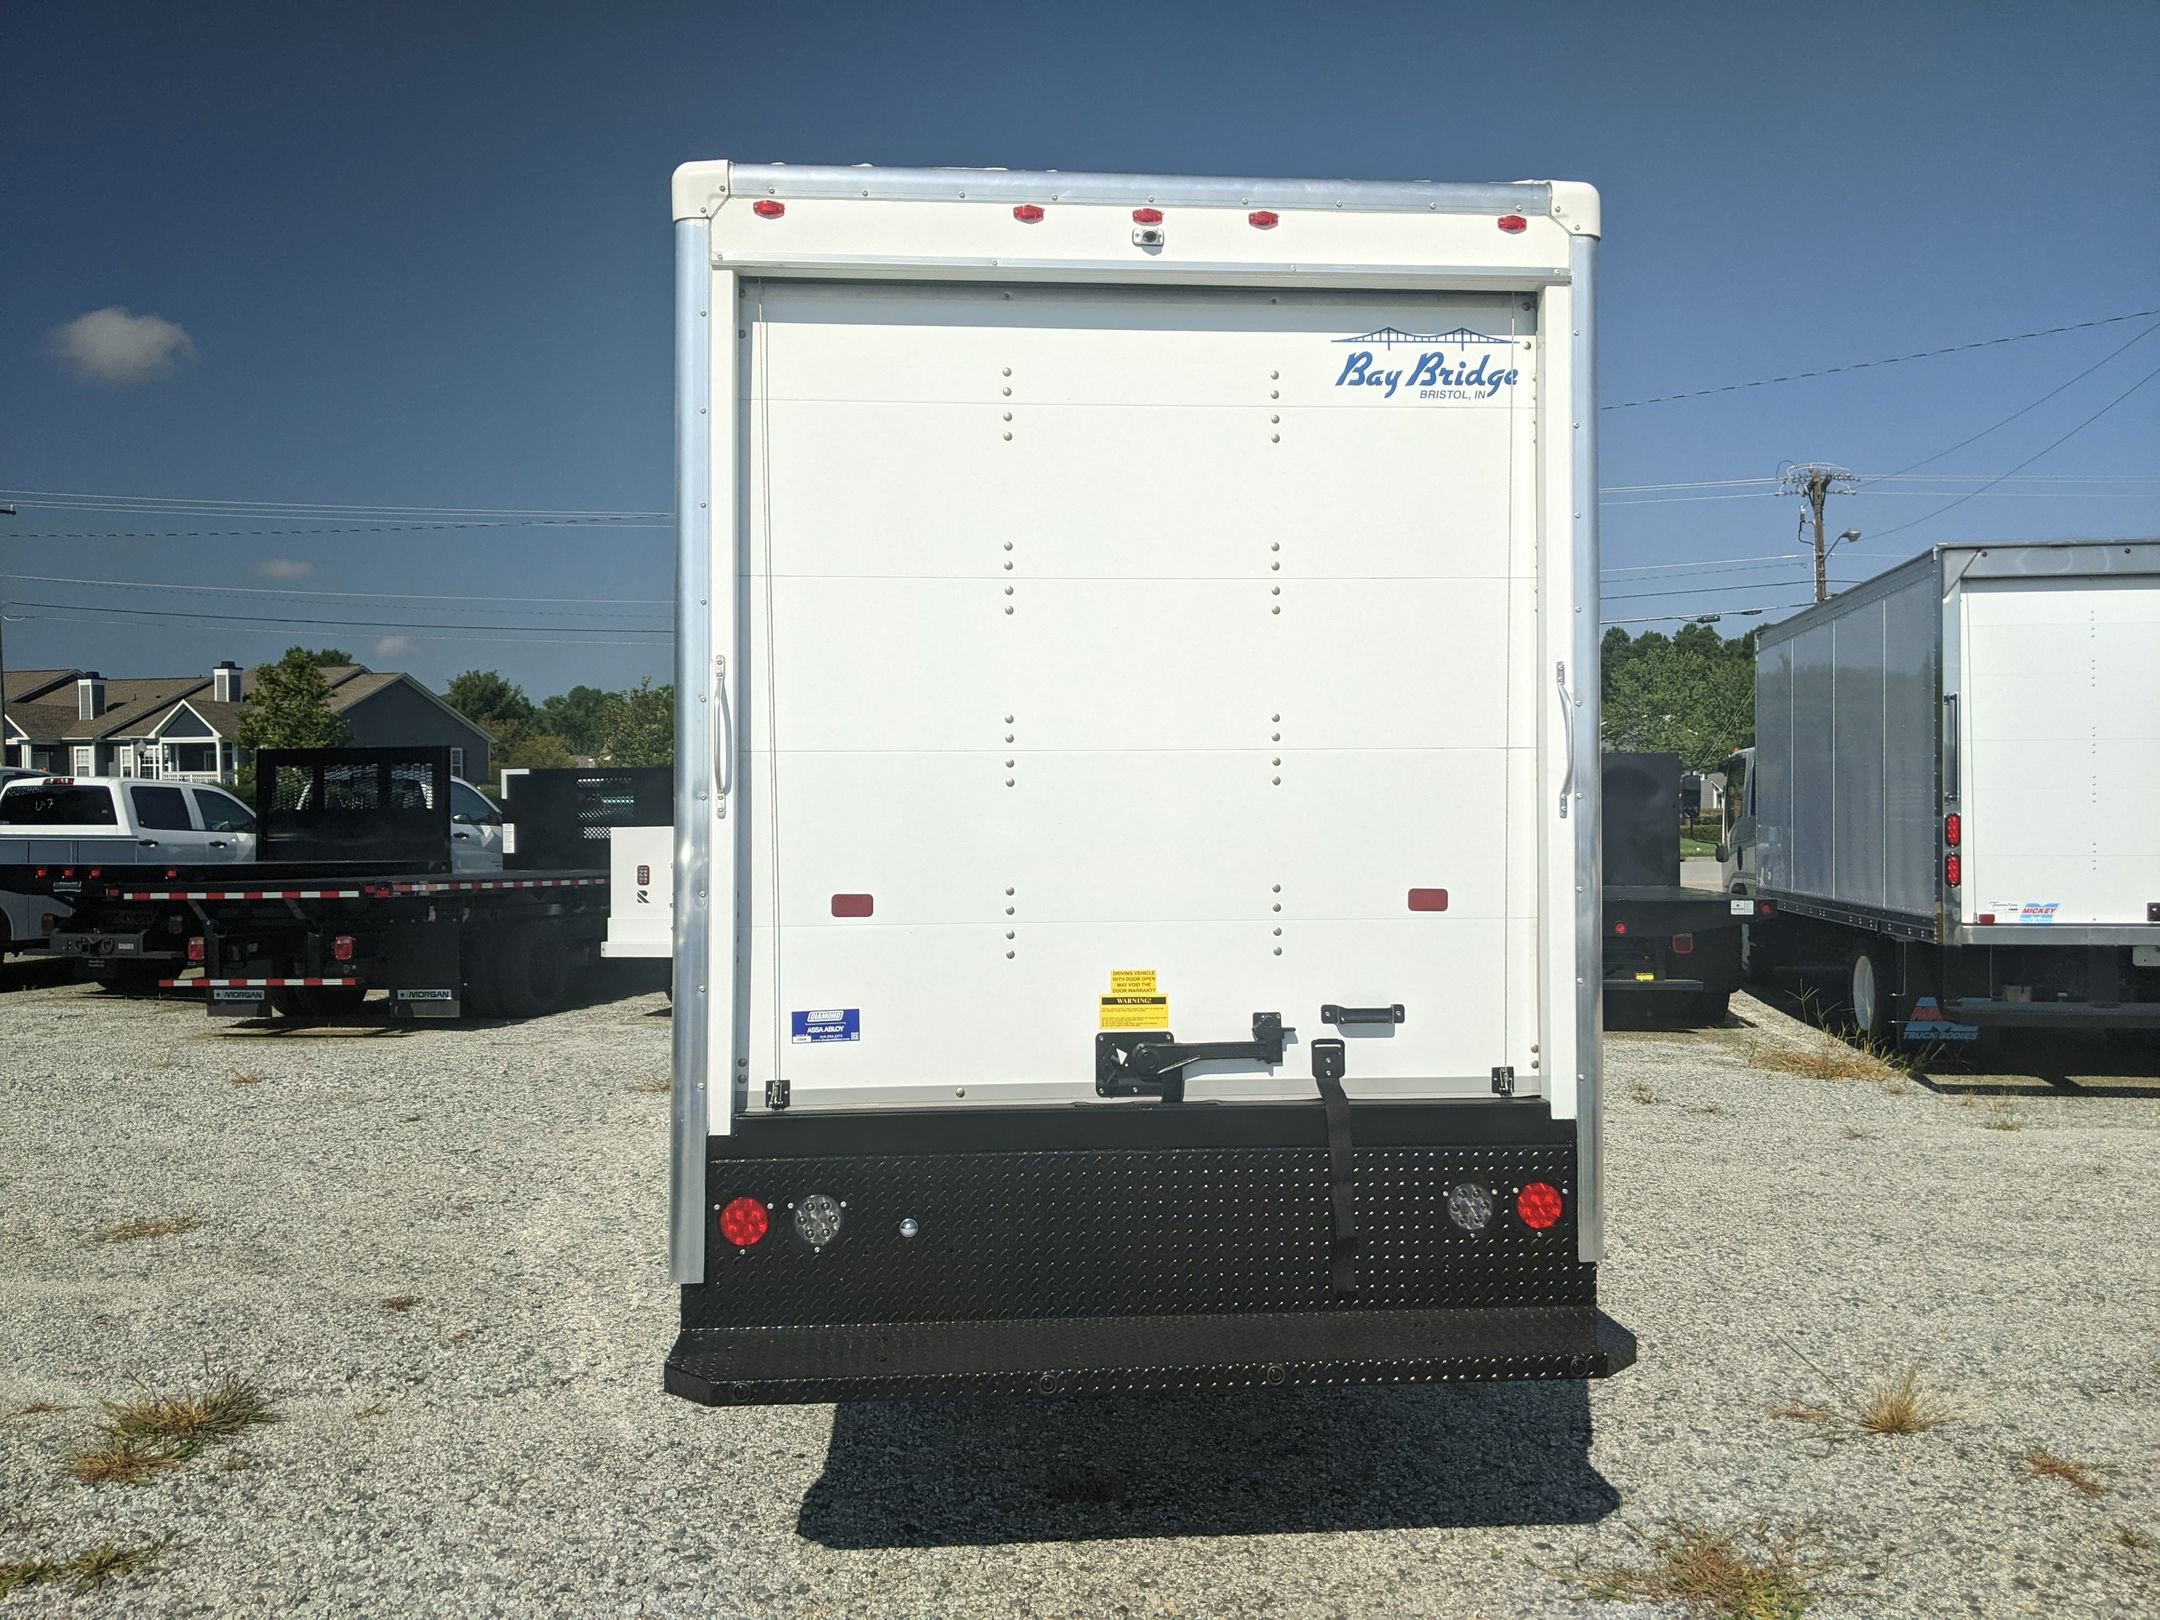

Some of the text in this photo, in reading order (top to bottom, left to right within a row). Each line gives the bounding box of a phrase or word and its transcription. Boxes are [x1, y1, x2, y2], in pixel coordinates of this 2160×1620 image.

[1335, 351, 1519, 399] Bay Bridge
[1420, 390, 1486, 401] BRISTOL, IN
[810, 1012, 841, 1020] DIAMOND
[1903, 1031, 1938, 1040] TRUCK
